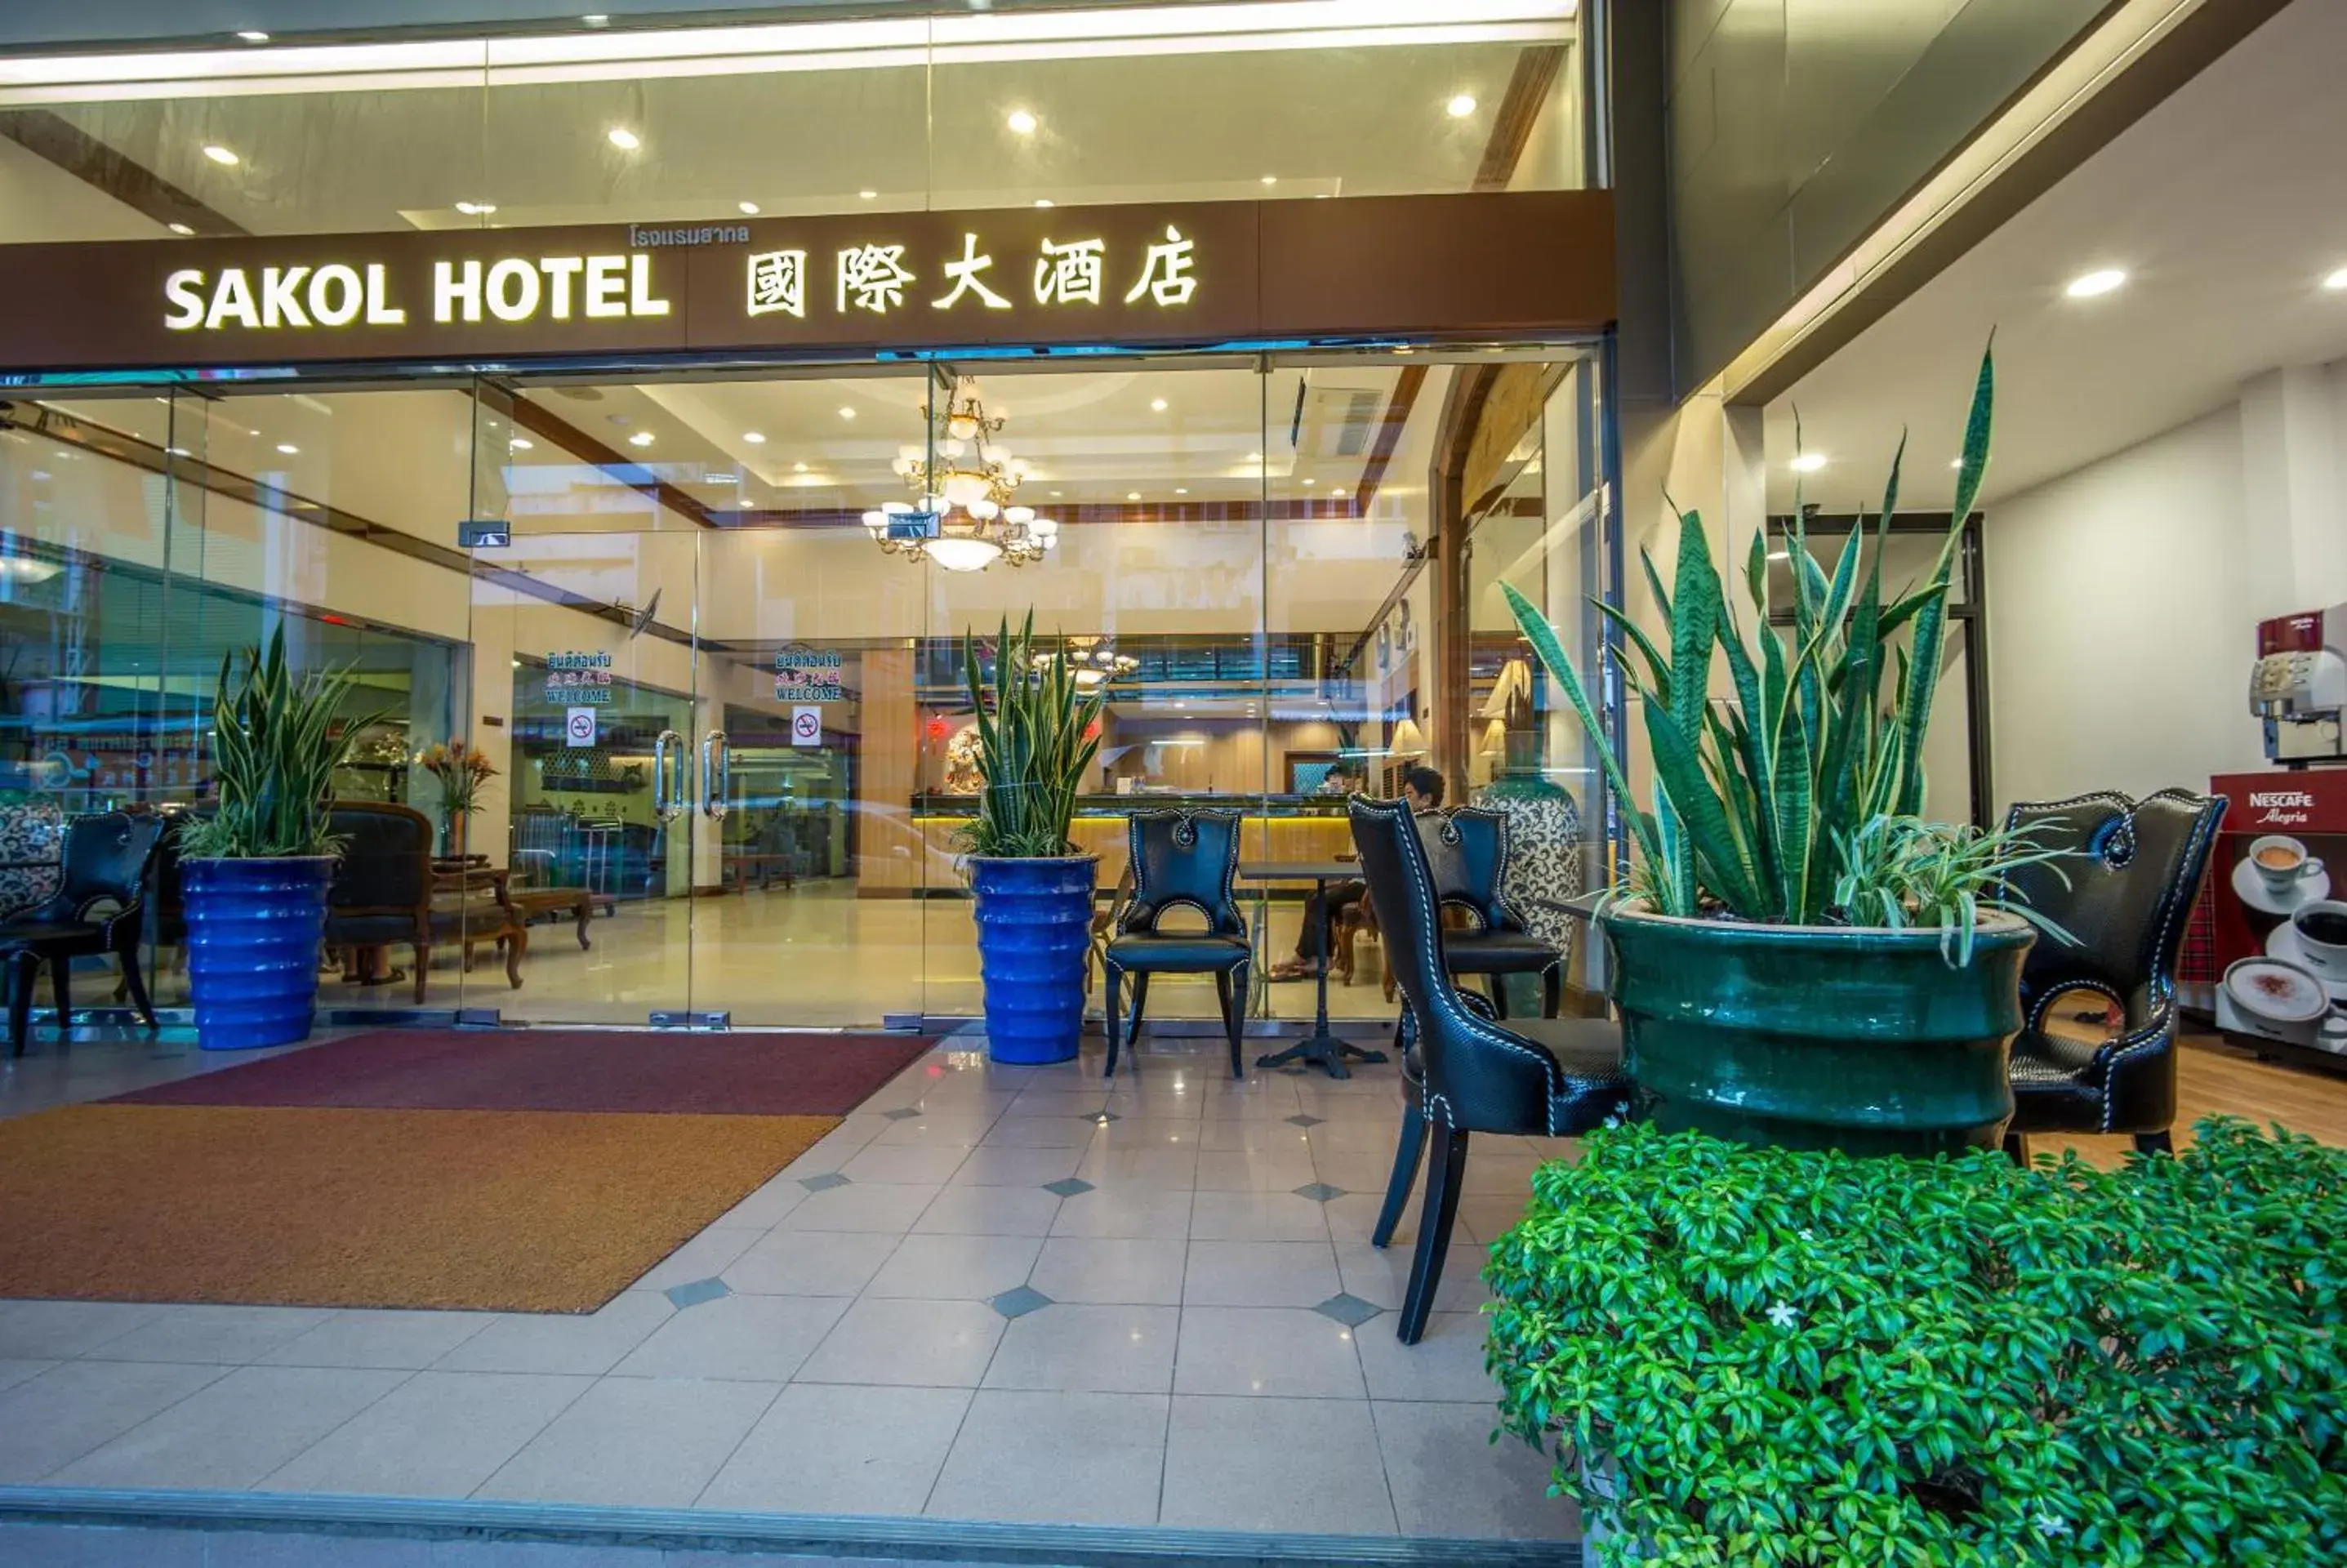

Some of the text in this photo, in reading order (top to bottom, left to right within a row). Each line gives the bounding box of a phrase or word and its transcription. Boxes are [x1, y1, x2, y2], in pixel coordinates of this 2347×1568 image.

[746, 225, 1197, 318] 國際大酒店
[164, 254, 670, 330] SAKOL HOTEL
[546, 689, 612, 703] WELCOME
[776, 687, 842, 701] WELCOME
[2256, 807, 2308, 826] Alegria
